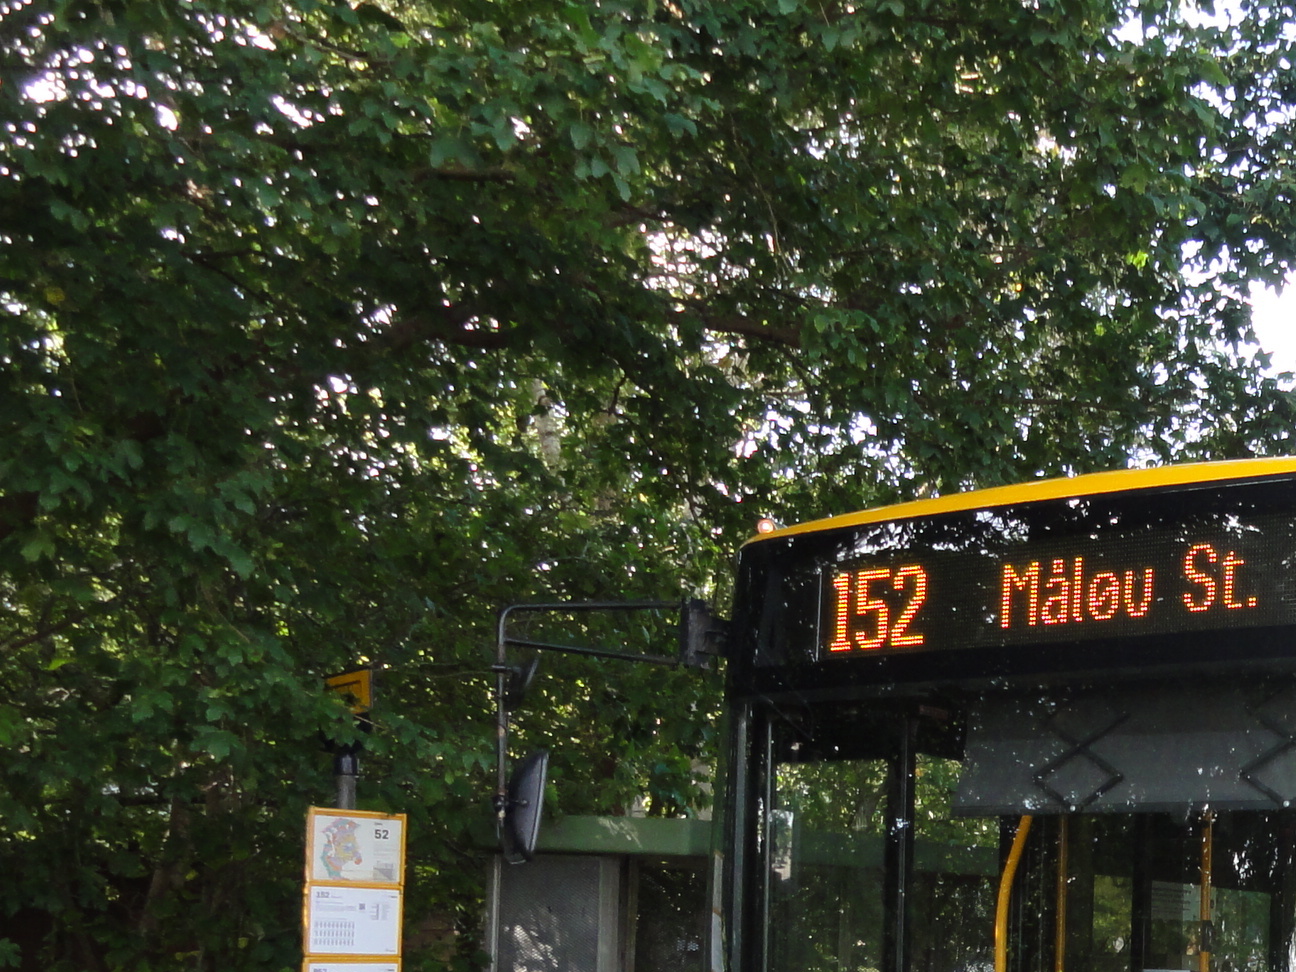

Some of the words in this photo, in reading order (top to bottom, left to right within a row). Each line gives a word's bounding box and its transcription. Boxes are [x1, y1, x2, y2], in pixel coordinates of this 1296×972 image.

[829, 565, 928, 652] 152
[1000, 556, 1153, 629] Måløv
[1184, 544, 1257, 612] St.
[374, 829, 389, 840] 52
